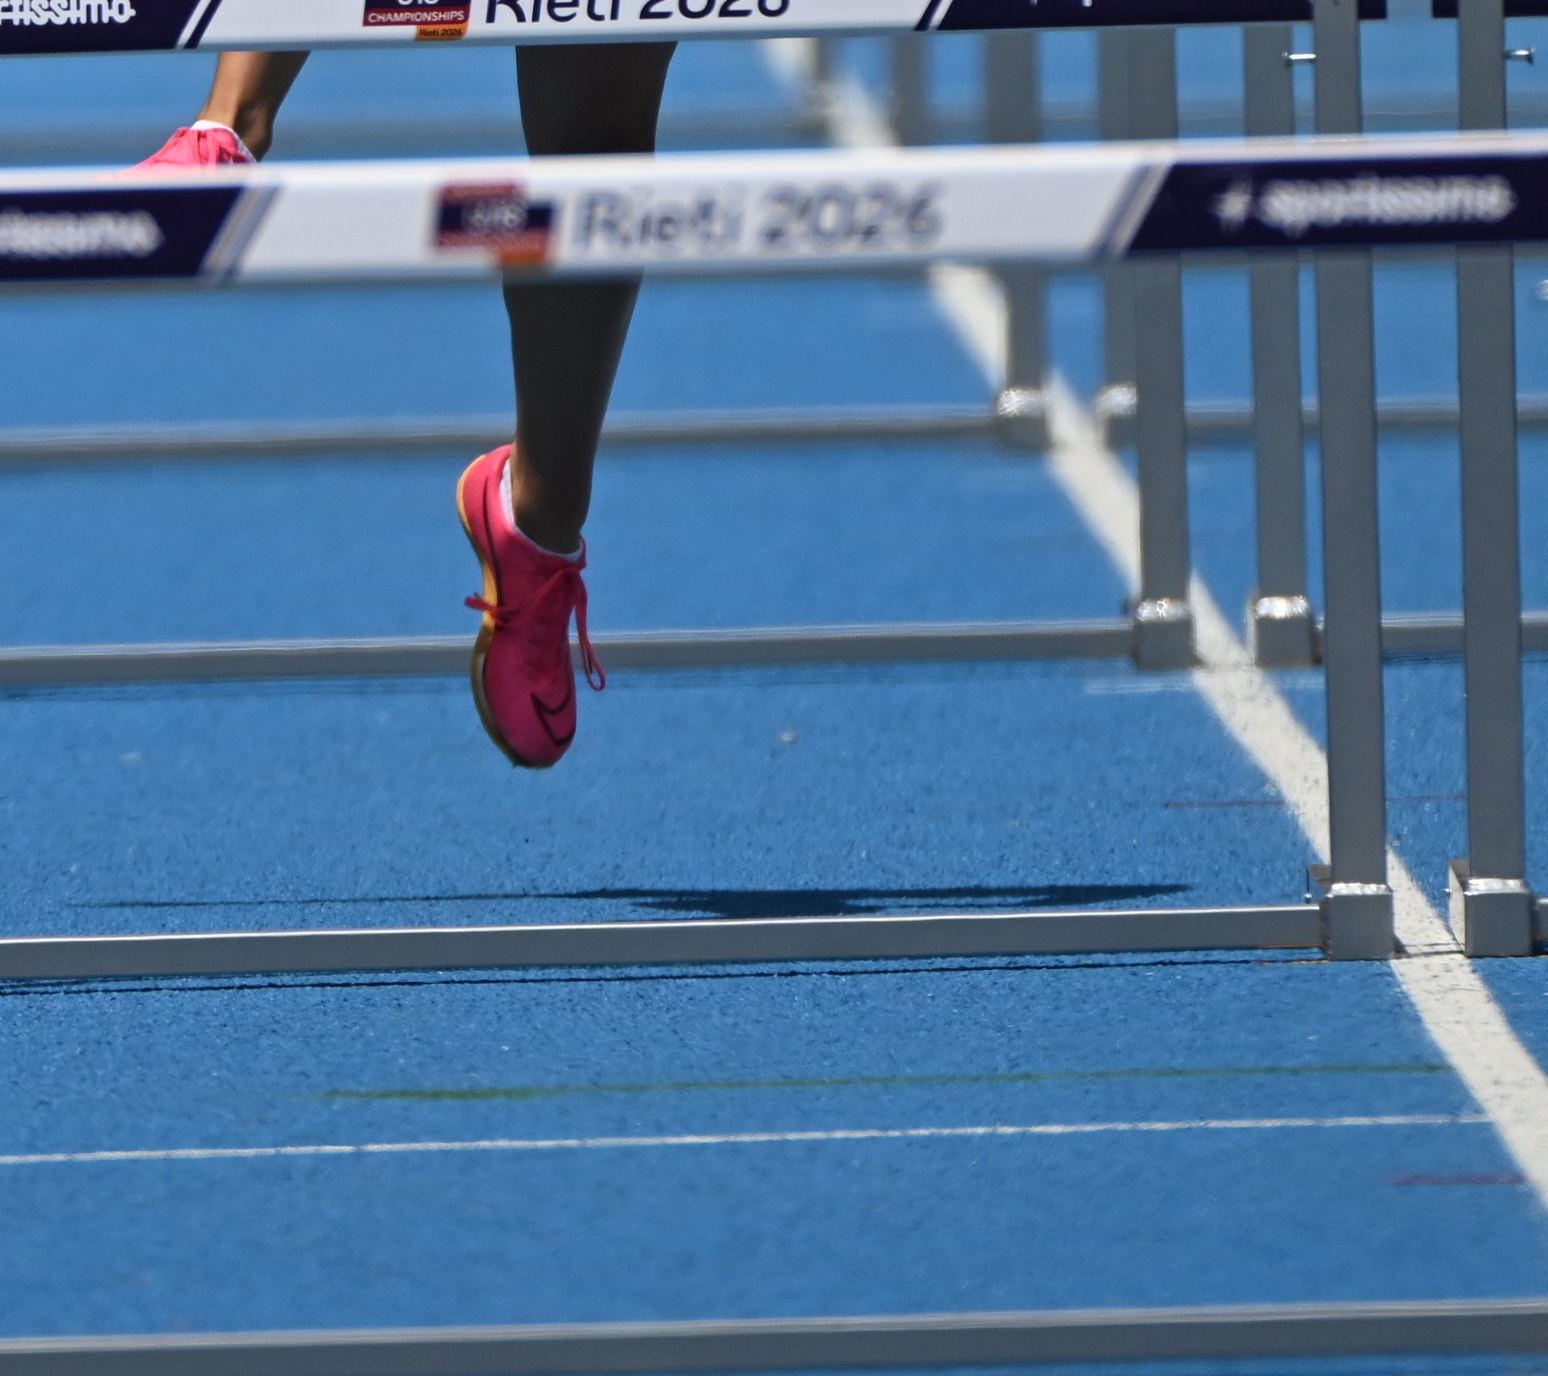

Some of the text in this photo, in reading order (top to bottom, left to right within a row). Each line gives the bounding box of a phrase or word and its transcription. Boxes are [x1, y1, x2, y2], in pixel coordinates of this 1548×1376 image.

[368, 11, 465, 23] CHAMPIONSHIPS
[575, 180, 944, 248] Rieti 2026
